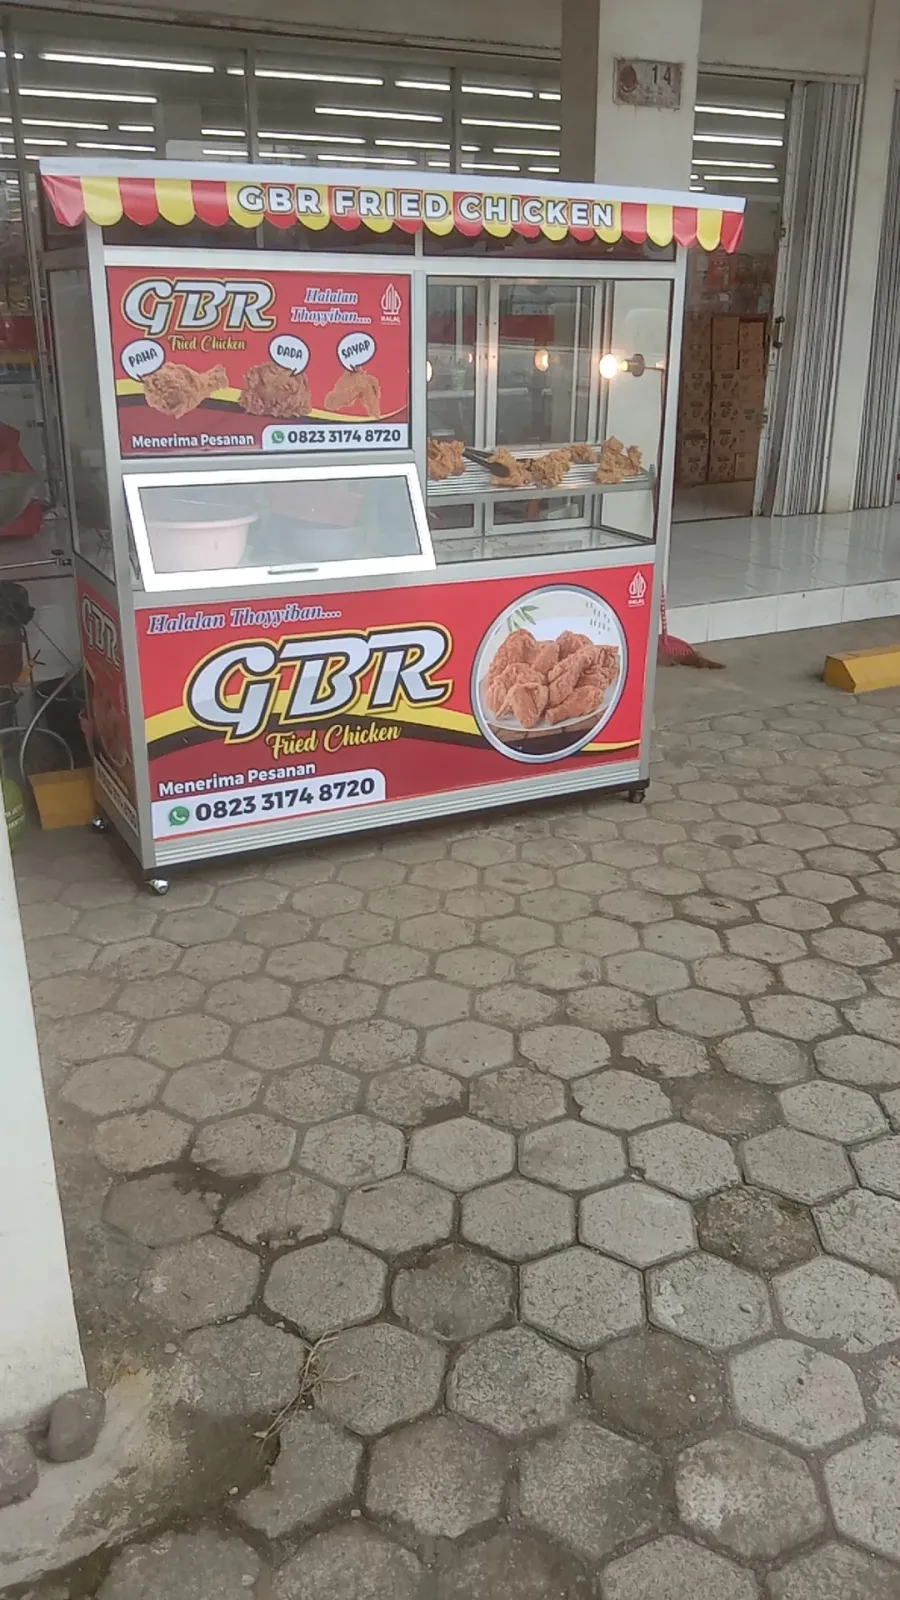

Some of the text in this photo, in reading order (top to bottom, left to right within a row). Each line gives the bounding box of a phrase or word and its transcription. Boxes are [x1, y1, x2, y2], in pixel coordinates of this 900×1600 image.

[652, 64, 671, 85] 14
[237, 184, 614, 228] GBR FRIED CHICKEN
[304, 288, 358, 304] Halalan
[122, 278, 275, 336] GBR
[168, 335, 246, 352] Fried Chicken
[276, 344, 303, 360] DADA
[341, 340, 371, 359] SAYAP
[128, 348, 158, 368] PAHA
[132, 434, 255, 448] Menerima Pesanan
[288, 429, 401, 444] 0823 3174 8720
[147, 612, 226, 635] Halalan
[186, 624, 451, 742] GBR
[266, 721, 400, 760] Fried Chicken
[159, 762, 316, 797] Menerima Pesanan
[195, 777, 375, 822] 0823 3174 8720
